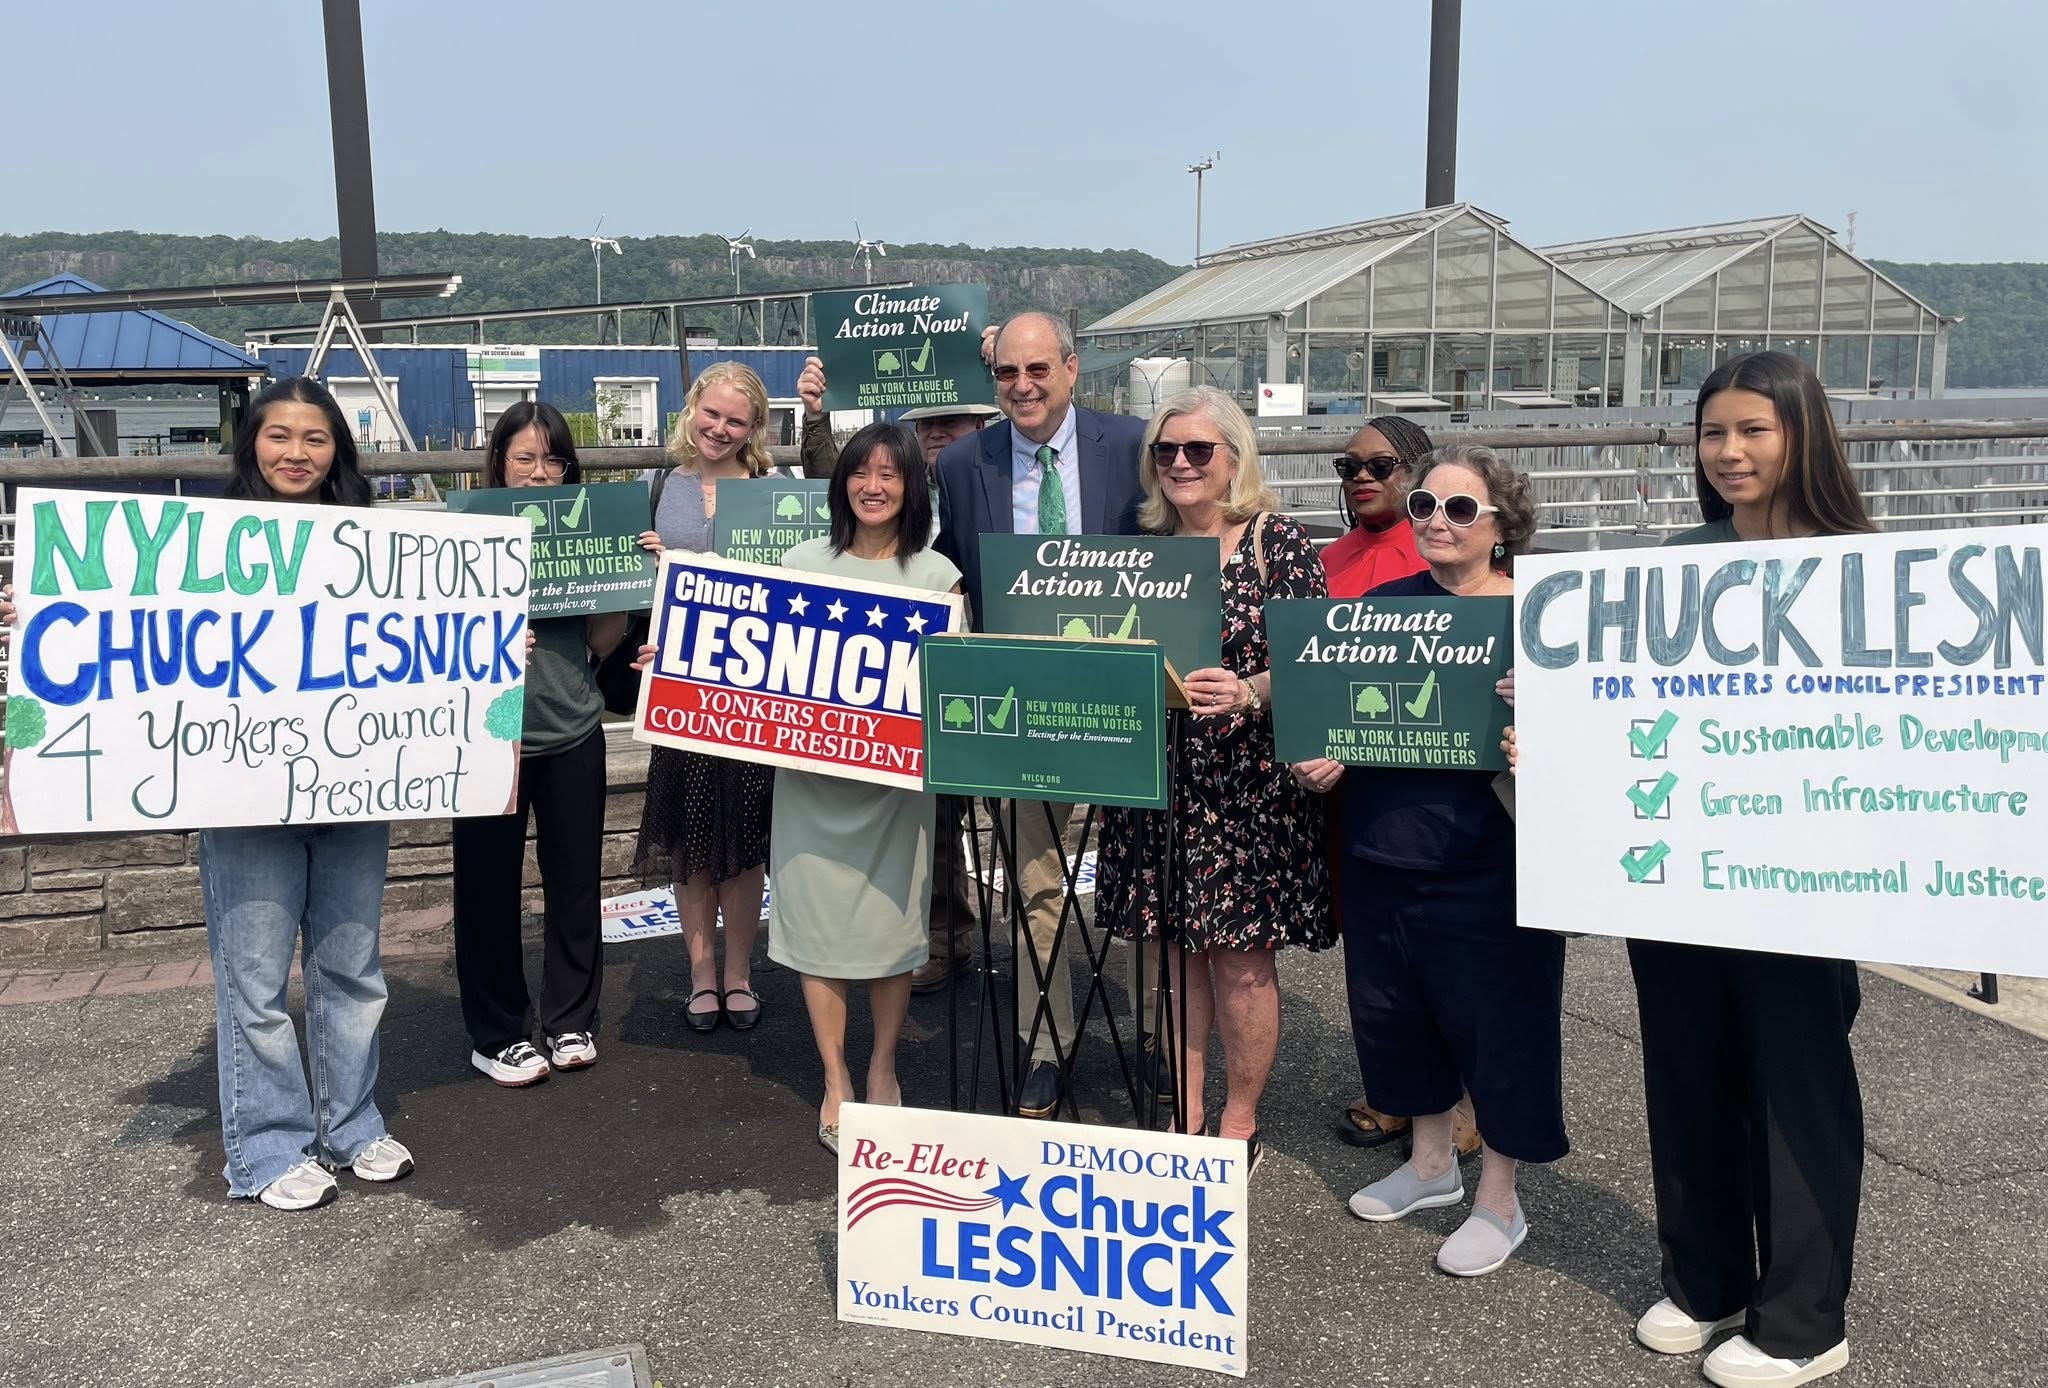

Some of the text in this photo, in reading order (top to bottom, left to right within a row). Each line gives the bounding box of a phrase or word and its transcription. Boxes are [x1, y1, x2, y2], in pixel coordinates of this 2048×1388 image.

[854, 292, 941, 315] Climate
[834, 311, 970, 339] Action Now!
[858, 391, 959, 407] CONSERVATION VOTERS
[859, 379, 954, 395] NEW YORK LEAGUE OF
[556, 537, 614, 557] LEAGUE
[618, 535, 636, 552] OF
[731, 529, 762, 545] NEW
[767, 529, 804, 545] YORK
[325, 519, 527, 600] SUPPORTS
[586, 555, 643, 575] VOTERS
[1036, 539, 1154, 569] Climate
[542, 582, 563, 597] the
[565, 578, 653, 596] Environment
[674, 570, 770, 613] Chuck
[1006, 569, 1193, 600] Action Now!
[1326, 602, 1453, 632] Climate
[1519, 556, 1823, 669] CHUCK
[21, 600, 526, 706] CHUCK LESNICK
[660, 605, 922, 714] LESNICK
[1295, 635, 1495, 665] Action Now!
[1592, 673, 2046, 700] FOR YONKERS COUNCIL PRESIDENT
[697, 688, 881, 738] YONKERS CITY
[1026, 700, 1137, 718] NEW YORK LEAGUE OF
[1026, 713, 1142, 731] CONSERVATION VOTERS
[650, 706, 923, 771] COUNCIL PRESIDENT
[1026, 729, 1132, 744] Electing for the Environment
[1328, 728, 1470, 748] NEW YORK LEAGUE OF
[1700, 713, 1884, 756] Sustainable
[37, 687, 472, 822] 4 Yonkers Council
[1325, 745, 1477, 766] CONSERVATION VOTERS
[280, 746, 469, 825] President
[1021, 773, 1061, 784] NYLCV.ORG
[1700, 775, 2029, 817] Green Infrastructure
[1700, 850, 2047, 902] Environmental Justice
[848, 1138, 990, 1180] Re-Elect
[1041, 1141, 1235, 1185] DEMOCRAT
[1038, 1173, 1236, 1248] Chuck
[922, 1217, 1236, 1317] LESNICK
[847, 1280, 1236, 1356] Yonkers Council President
